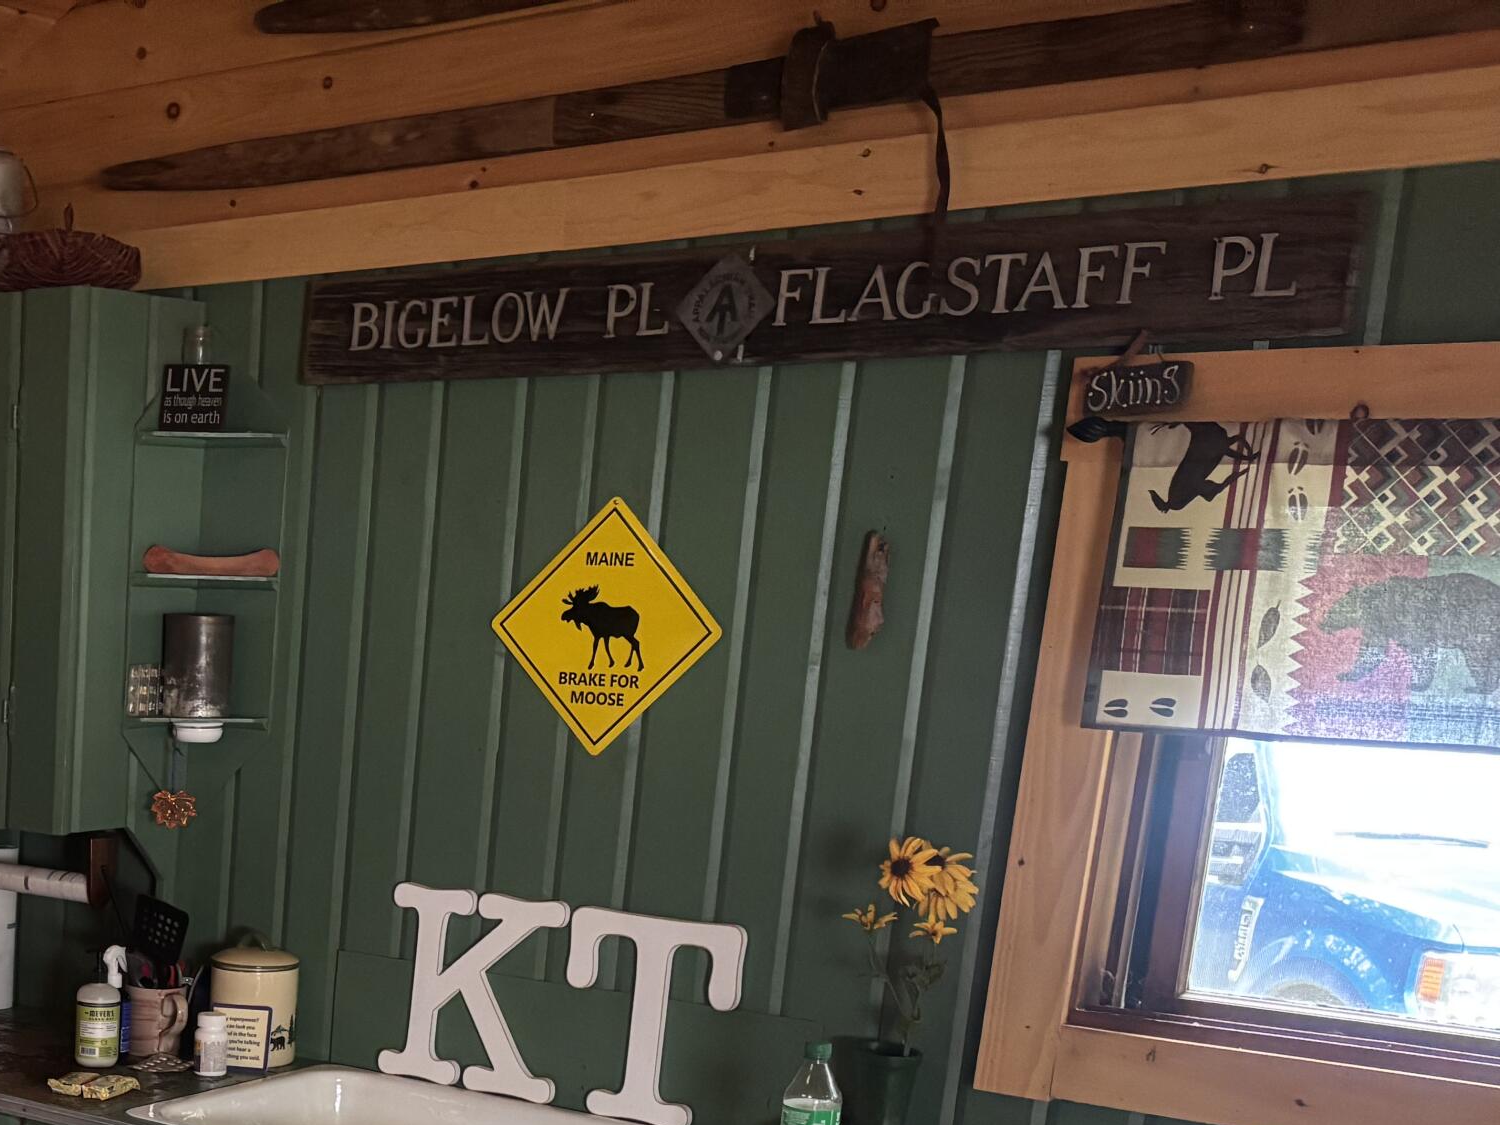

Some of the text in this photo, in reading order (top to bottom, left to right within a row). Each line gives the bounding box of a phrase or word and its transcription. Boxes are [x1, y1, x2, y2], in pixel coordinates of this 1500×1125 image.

[771, 232, 1297, 327] FLAGSTAFF PL
[348, 281, 670, 351] BIGELOW PL
[166, 368, 226, 392] LIVE
[163, 410, 221, 424] is on earth
[585, 551, 635, 567] MAINE
[558, 671, 639, 689] BRAKE FOR
[570, 690, 625, 706] MOOSE
